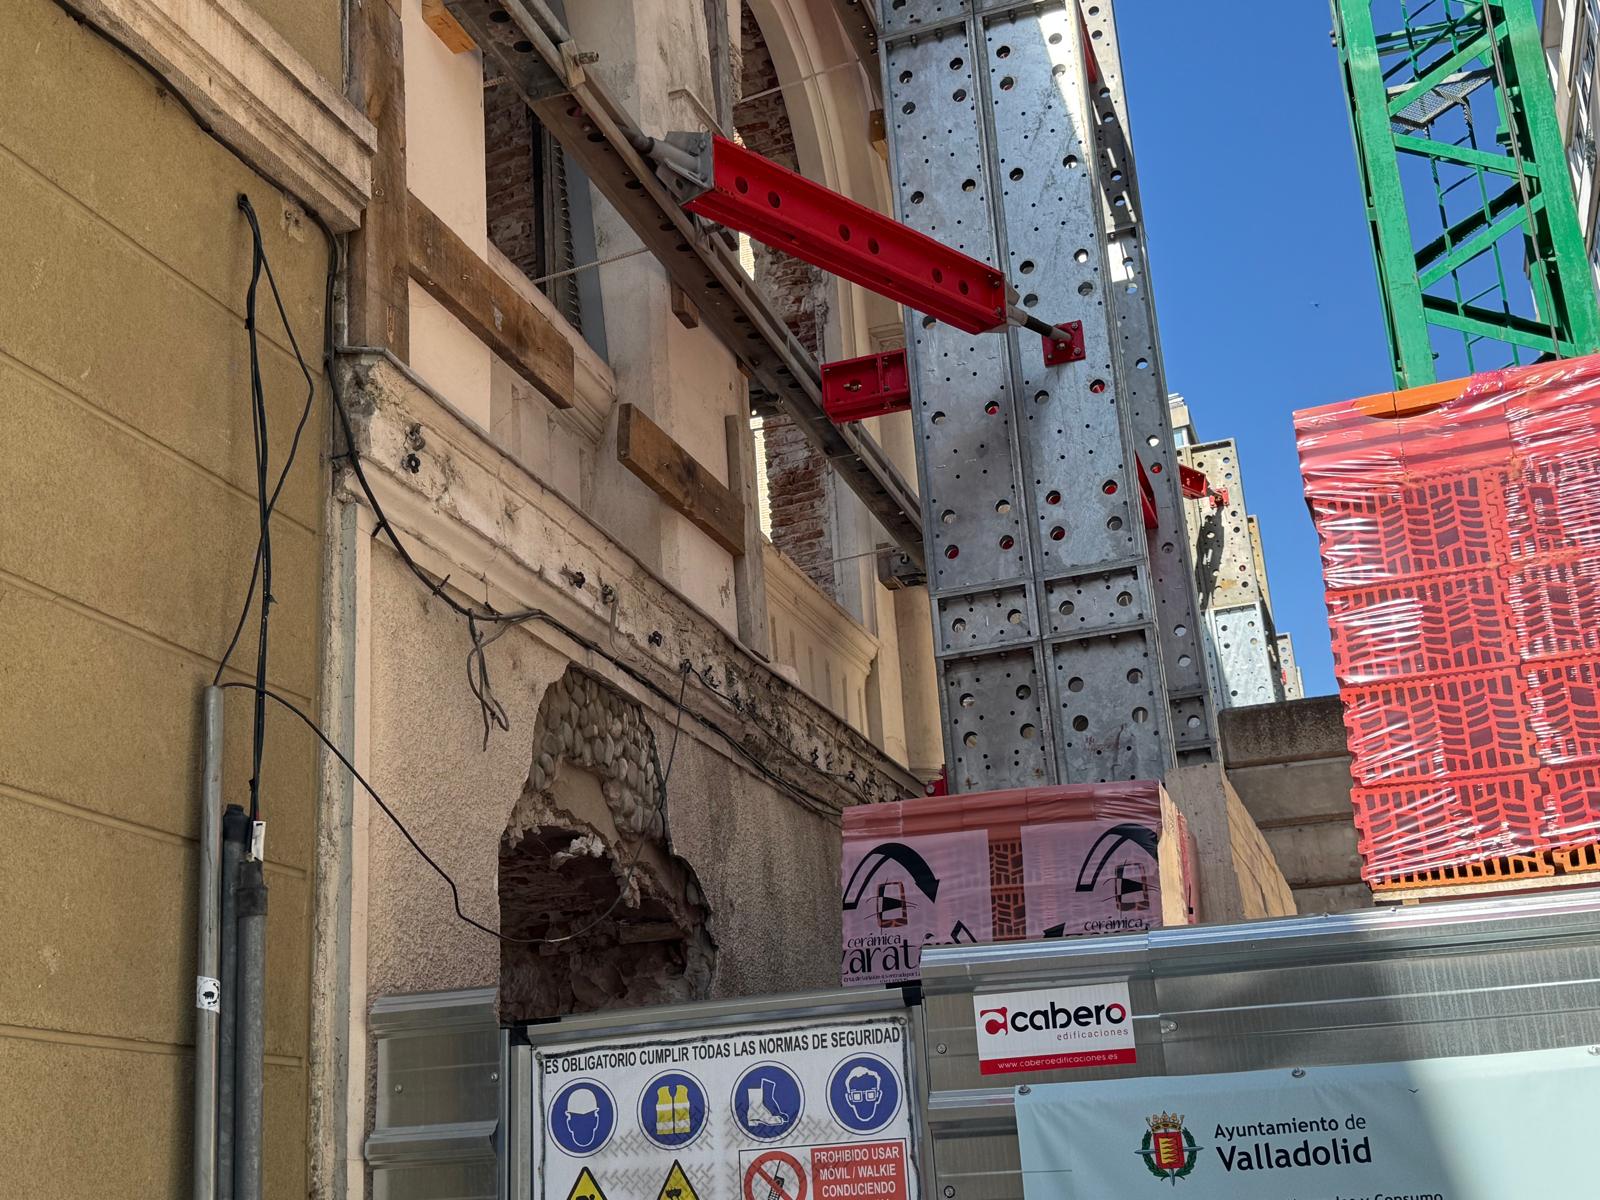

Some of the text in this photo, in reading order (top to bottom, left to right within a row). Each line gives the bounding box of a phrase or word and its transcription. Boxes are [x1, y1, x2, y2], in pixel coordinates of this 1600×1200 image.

[1084, 916, 1143, 931] cerámica
[847, 933, 901, 948] cerámica
[1010, 1001, 1127, 1032] cabero
[1056, 1028, 1129, 1041] edificaciones
[544, 1027, 900, 1075] ES OBLIGATORIO CUMPLIR TODAS LAS NORMAS DE SEGURIDAD
[997, 1053, 1118, 1070] www.caberoedificaciones.es
[1214, 1113, 1367, 1142] Ayuntamiento de
[814, 1146, 900, 1164] PROHIBIDO USAR
[1216, 1136, 1372, 1172] Valladolid
[820, 1165, 851, 1181] MÓVIL
[858, 1163, 897, 1178] WALKIE
[822, 1181, 896, 1198] CONDUCIENDO
